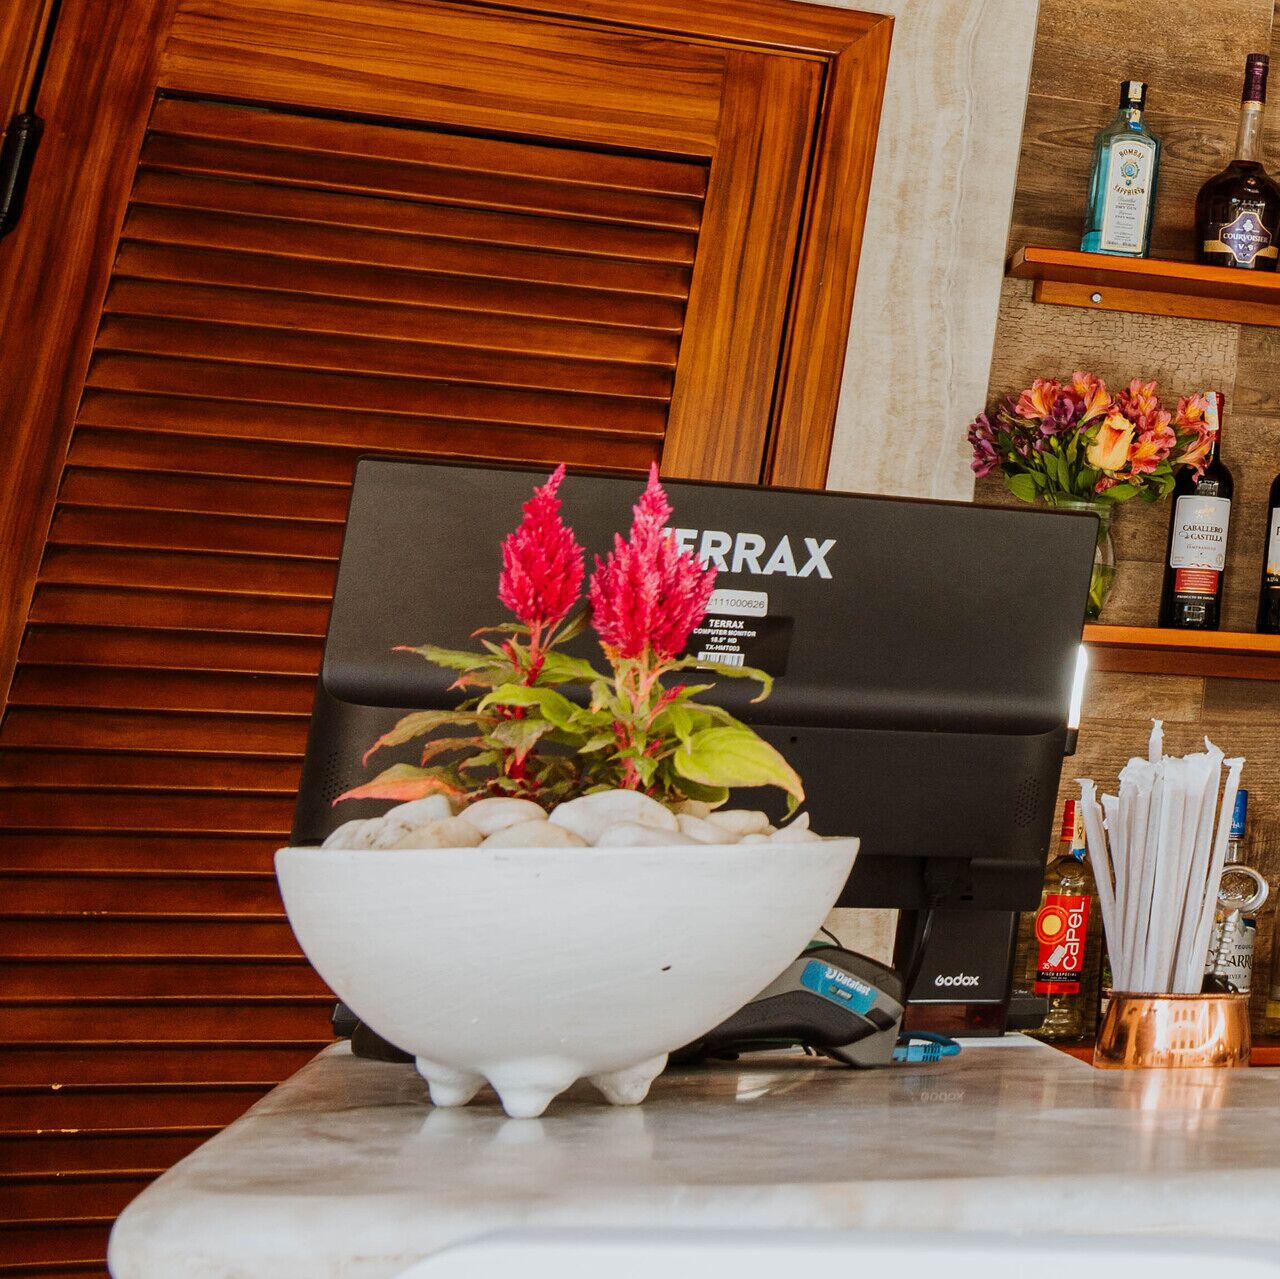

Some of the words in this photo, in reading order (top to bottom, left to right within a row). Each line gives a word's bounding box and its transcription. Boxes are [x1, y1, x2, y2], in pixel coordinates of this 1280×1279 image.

[1118, 148, 1145, 160] BOMBAY
[1223, 232, 1269, 244] COURVOISIER
[1182, 524, 1223, 534] CABALLERO
[1190, 533, 1223, 543] CASTILLA
[663, 527, 838, 580] ERRAX
[708, 619, 745, 630] TERRAX
[693, 627, 729, 637] COMPUTER
[728, 629, 758, 638] MONITOR
[835, 972, 872, 996] Datafast
[934, 973, 980, 988] Godox
